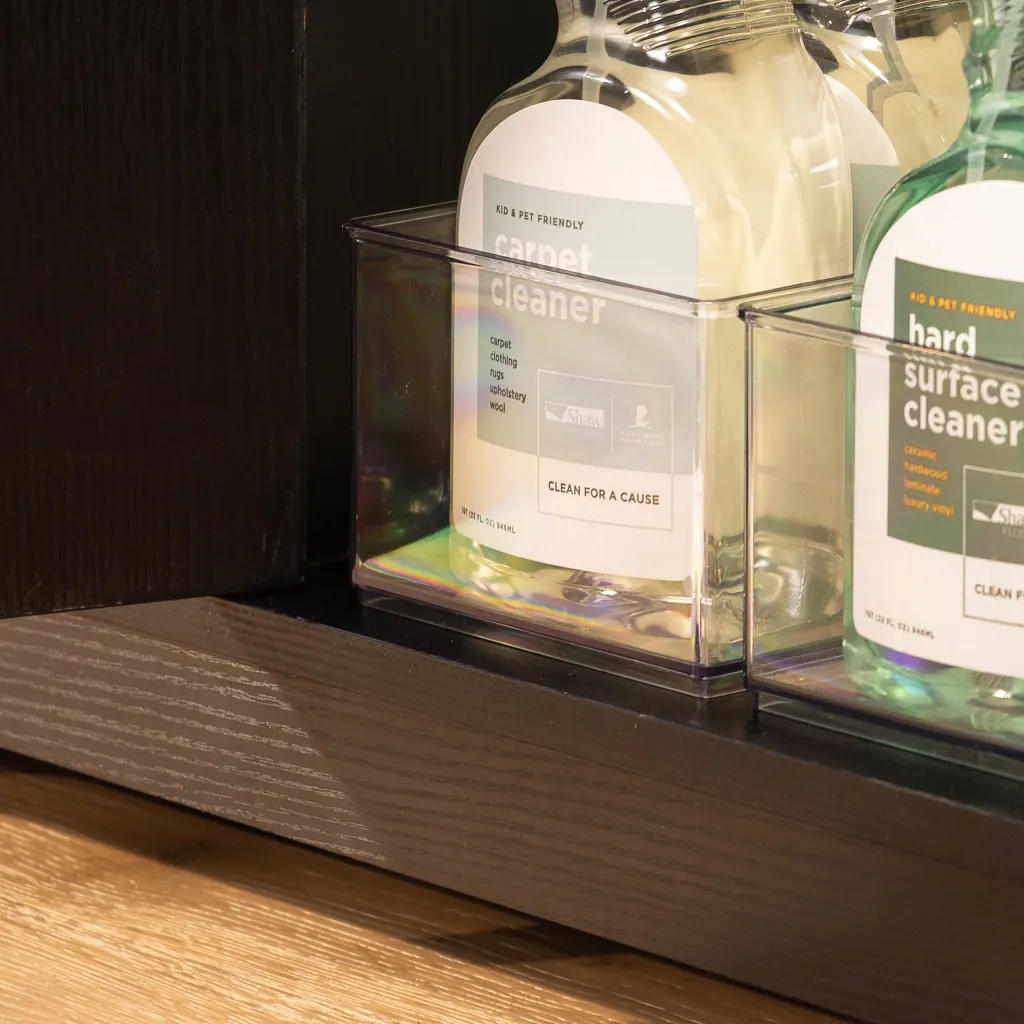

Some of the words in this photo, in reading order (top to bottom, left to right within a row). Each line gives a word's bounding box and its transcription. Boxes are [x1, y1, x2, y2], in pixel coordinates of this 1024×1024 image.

[496, 204, 508, 215] KID
[511, 208, 516, 217] &
[519, 210, 534, 222] PET
[538, 214, 584, 230] FRIENDLY
[495, 233, 595, 275] carpet
[490, 276, 606, 324] cleaner
[910, 291, 926, 304] KID
[938, 297, 957, 311] PET
[961, 301, 1016, 321] FRIENDLY
[490, 336, 512, 349] carpet
[909, 313, 976, 357] hard
[490, 351, 518, 369] clothing
[490, 368, 504, 380] rugs
[904, 360, 1021, 408] surface
[490, 384, 526, 404] upholstery
[490, 401, 505, 412] wool
[903, 396, 1024, 446] cleaner
[904, 444, 938, 462] ceramic
[904, 460, 948, 481] hardwood
[548, 480, 580, 496] CLEAN
[584, 487, 606, 500] FOR
[609, 491, 616, 501] A
[621, 492, 660, 505] CAUSE
[904, 477, 940, 496] laminate
[904, 493, 929, 513] luxury
[932, 503, 954, 518] vinyl
[974, 583, 1012, 600] CLEAN
